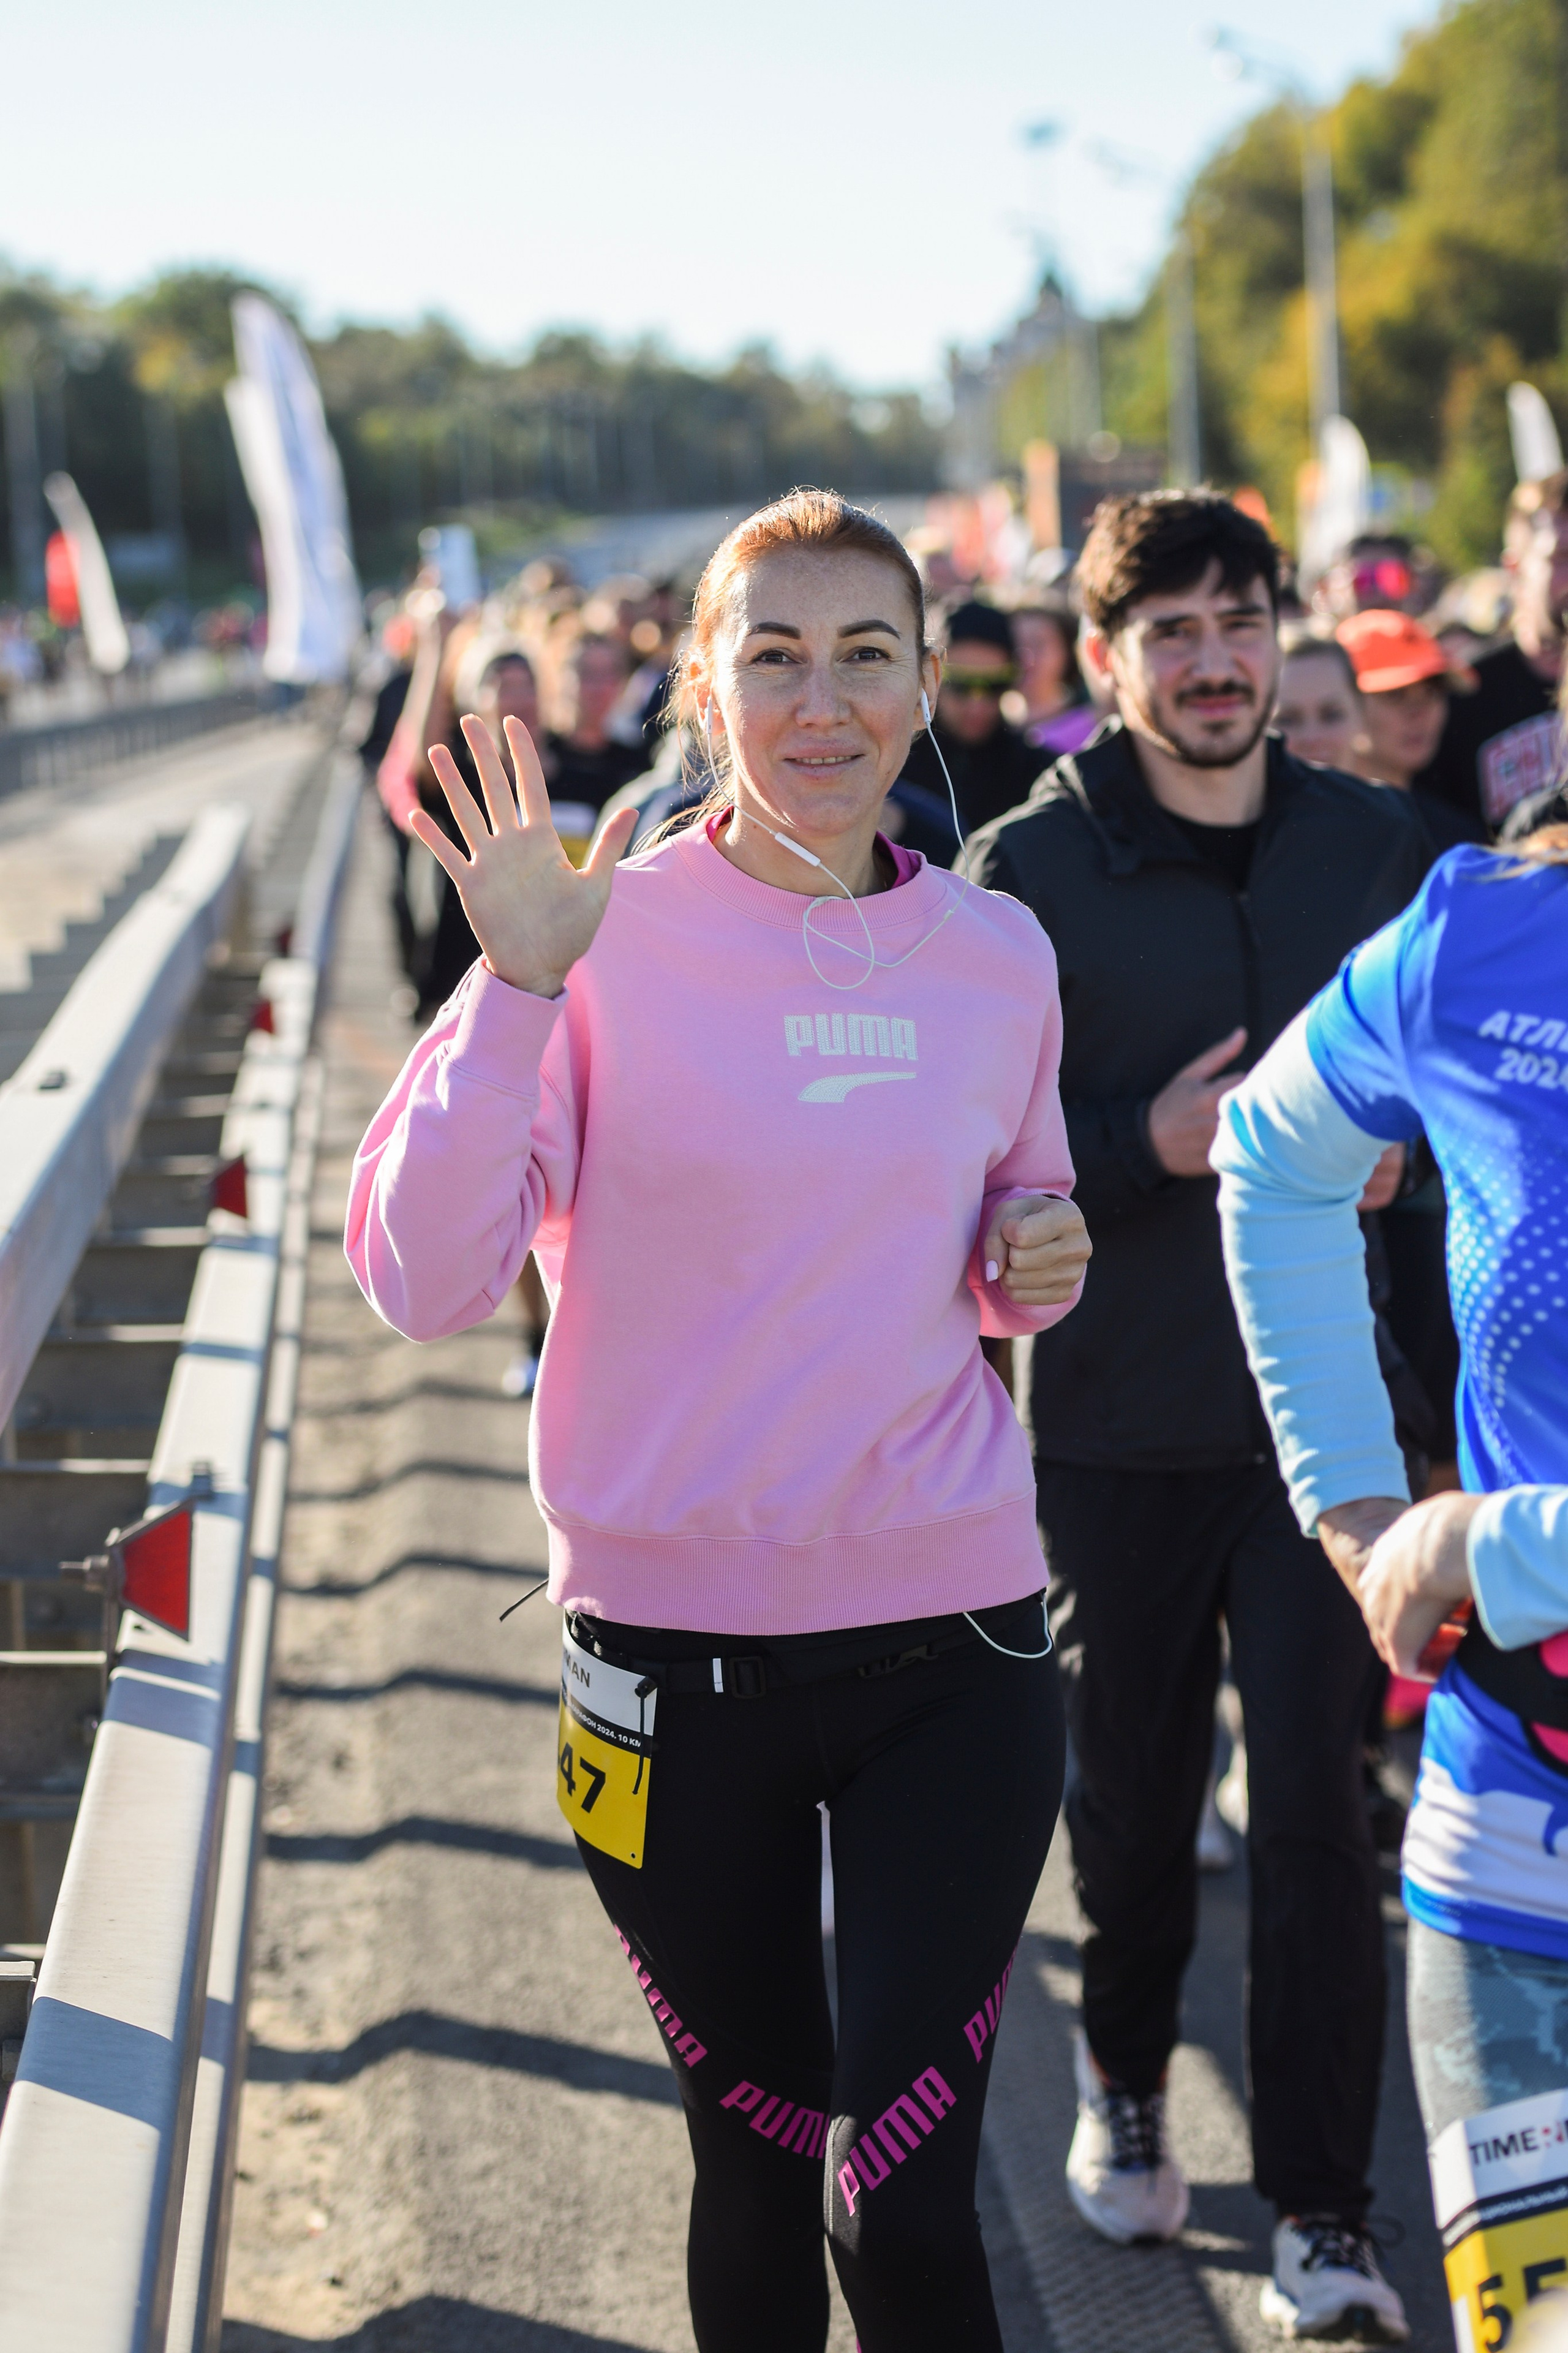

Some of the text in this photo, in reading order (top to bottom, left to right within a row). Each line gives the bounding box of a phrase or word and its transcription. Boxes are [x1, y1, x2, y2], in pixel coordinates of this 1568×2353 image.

[783, 1012, 919, 1060] PUMA
[618, 1734, 628, 1743] 10
[837, 2066, 957, 2217] PUMA
